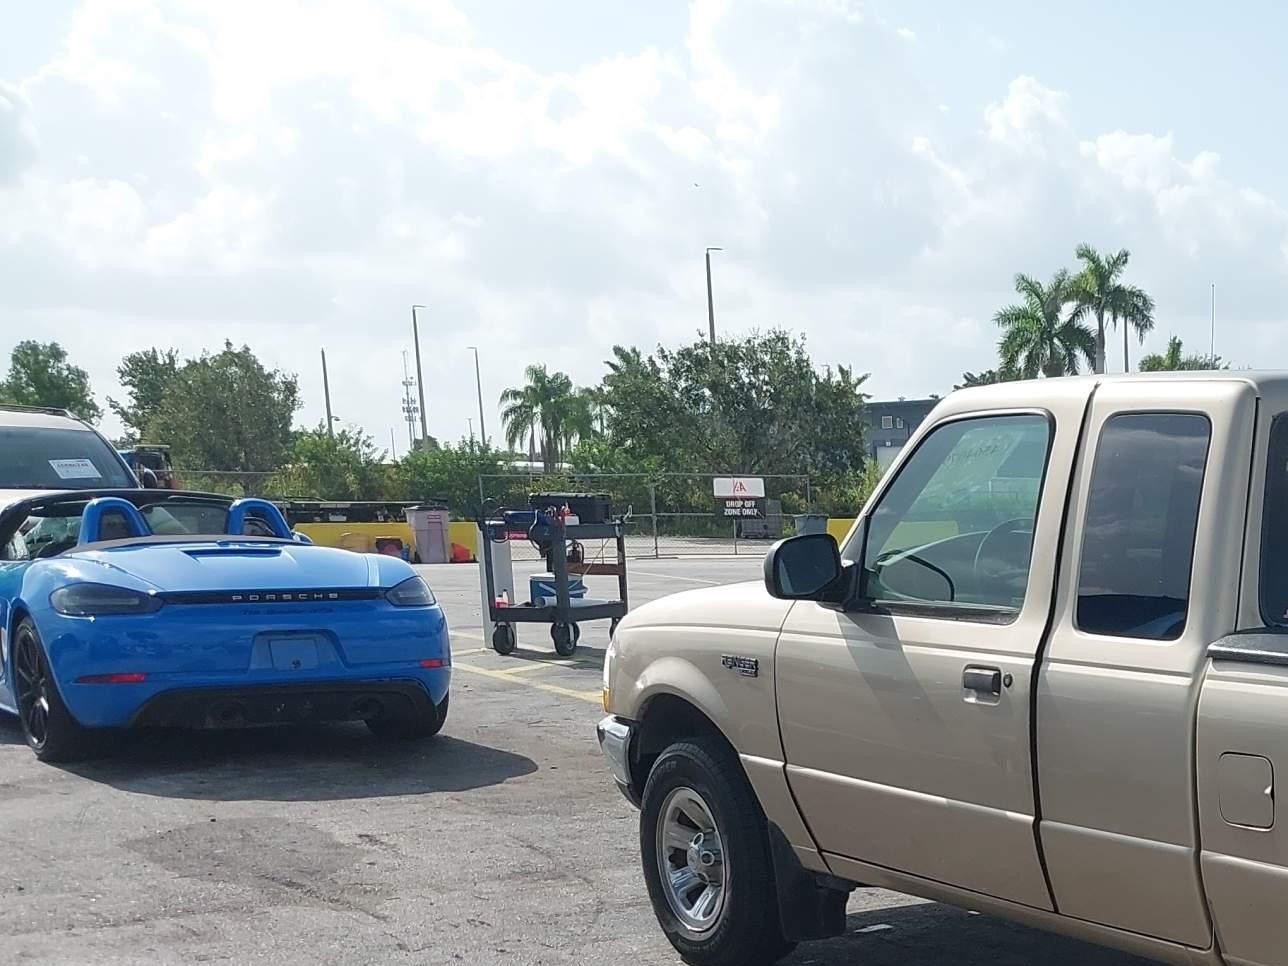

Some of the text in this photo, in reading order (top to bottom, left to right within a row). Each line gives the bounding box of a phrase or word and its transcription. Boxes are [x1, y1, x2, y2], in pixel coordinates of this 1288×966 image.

[725, 500, 756, 508] DROP OFF
[723, 508, 758, 516] ZONE ONLY
[231, 592, 339, 601] PORSCHE
